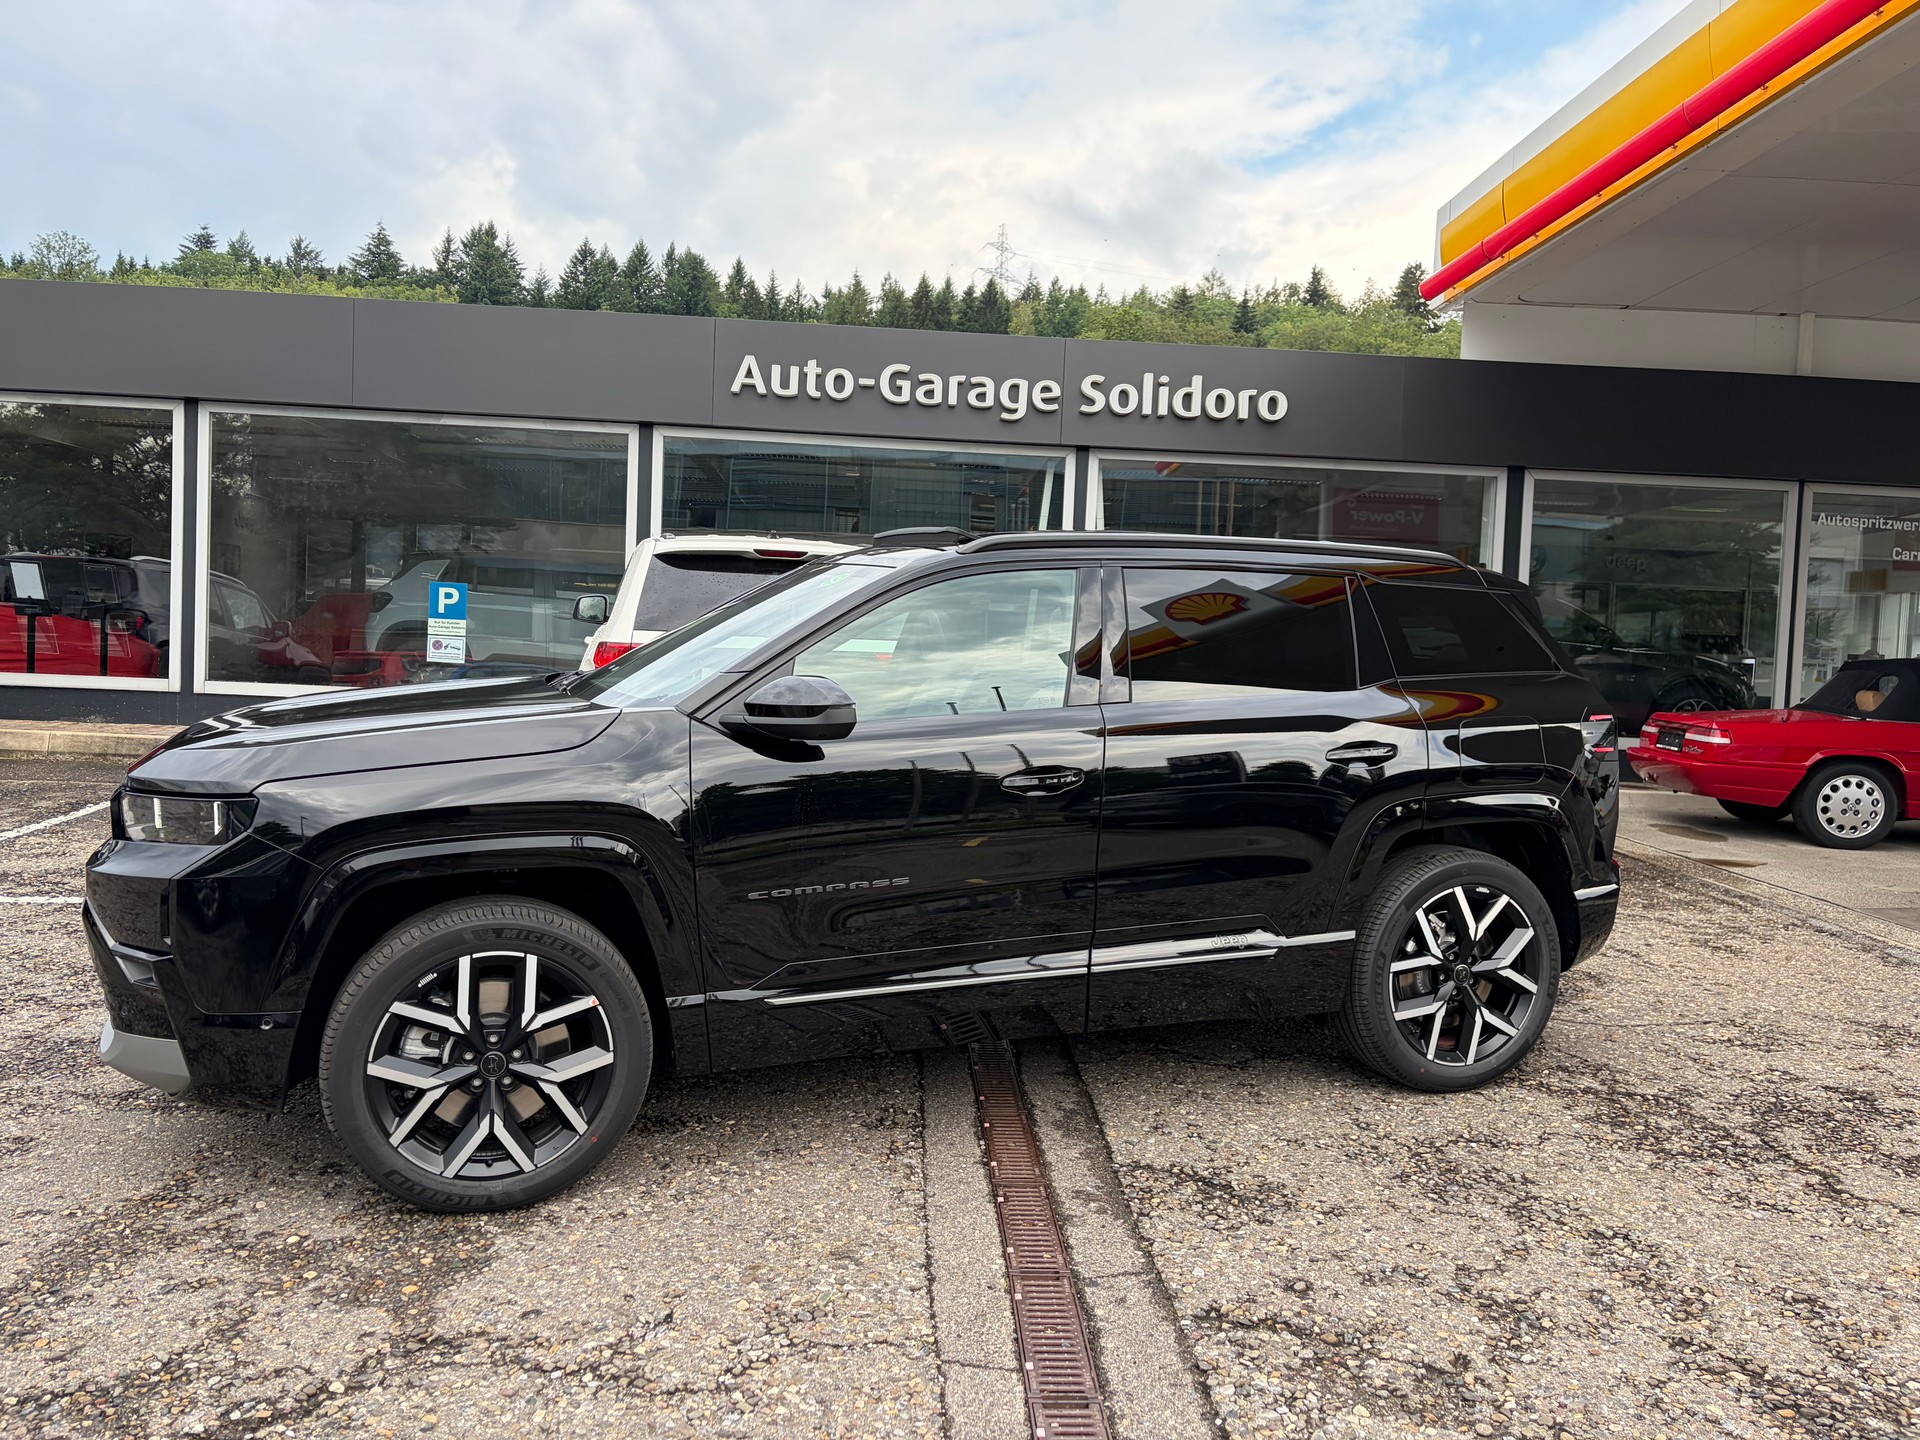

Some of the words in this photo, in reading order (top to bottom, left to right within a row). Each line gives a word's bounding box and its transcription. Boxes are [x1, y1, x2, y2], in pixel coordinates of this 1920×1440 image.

[730, 354, 1061, 421] Auto-Garage
[1078, 372, 1289, 422] Solidoro
[438, 587, 459, 613] P
[748, 877, 909, 900] COMPASS
[501, 928, 595, 967] MICHELIN
[1211, 934, 1248, 949] Jeep
[388, 1172, 488, 1206] MICHELIN
